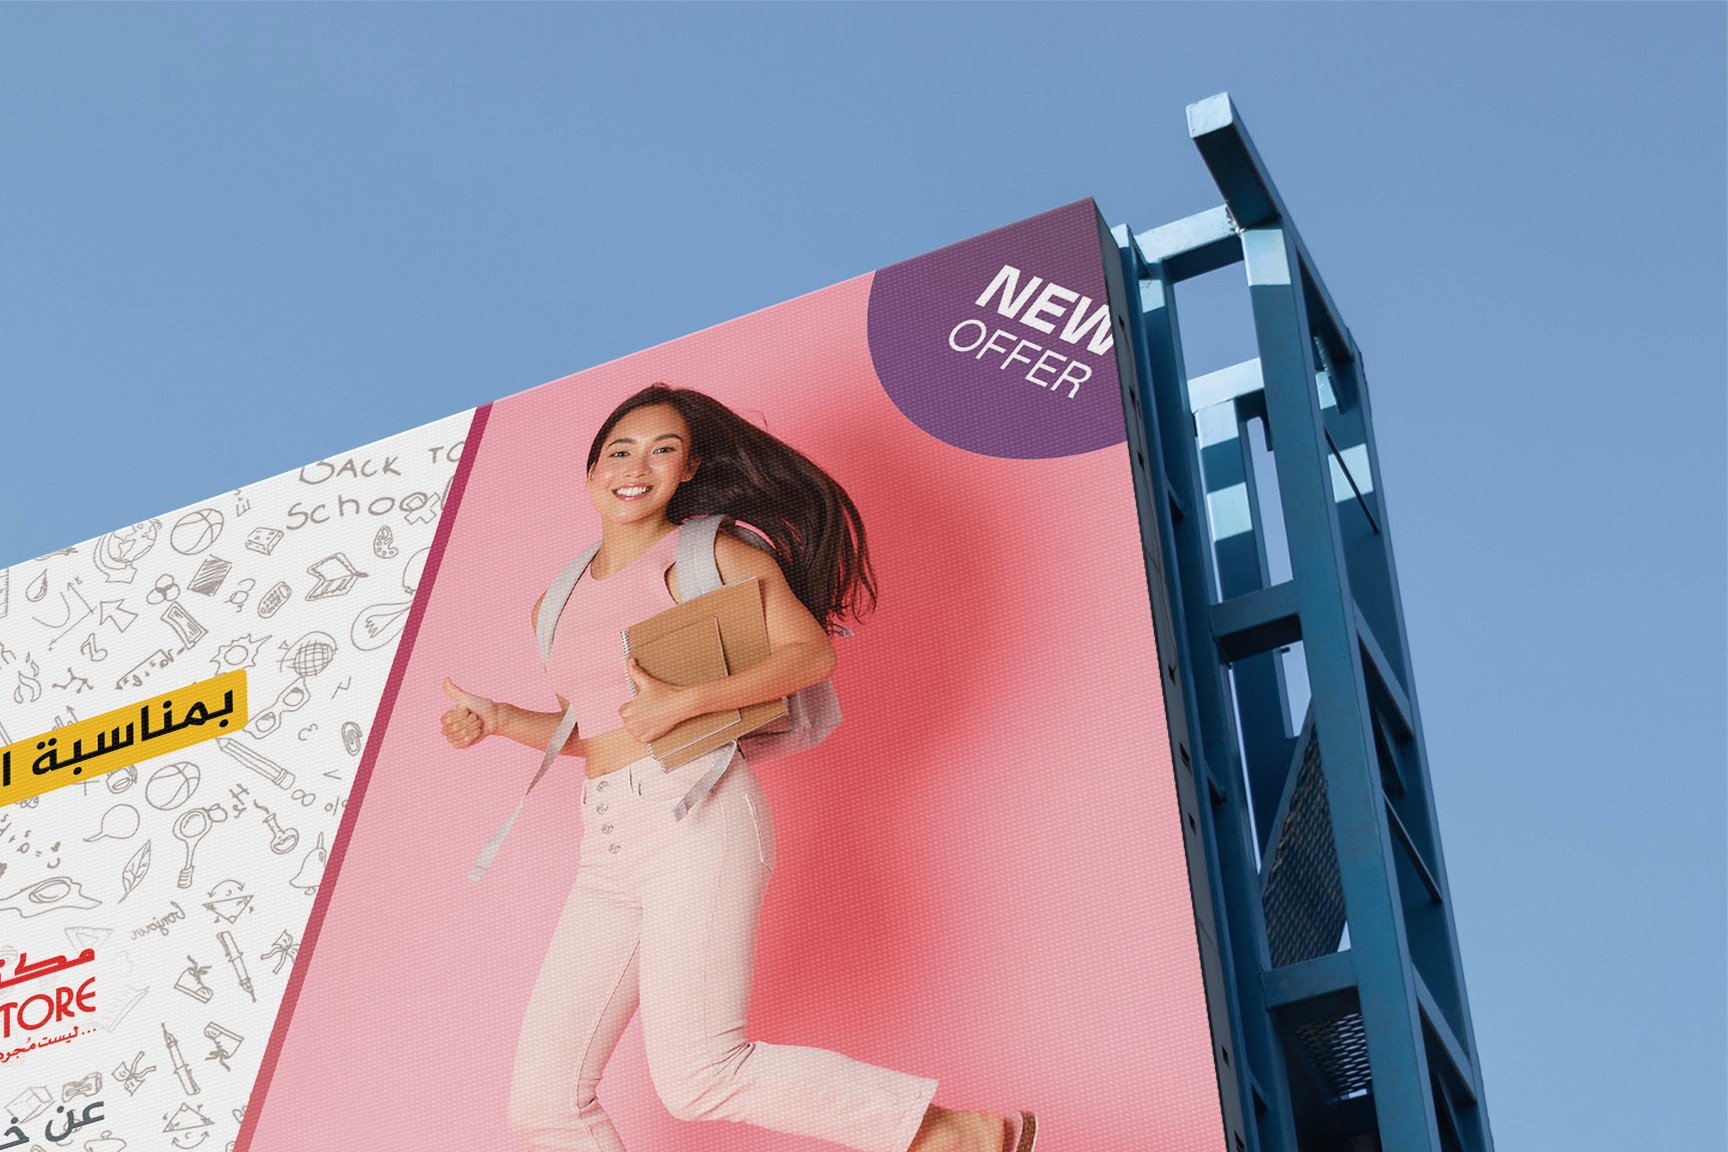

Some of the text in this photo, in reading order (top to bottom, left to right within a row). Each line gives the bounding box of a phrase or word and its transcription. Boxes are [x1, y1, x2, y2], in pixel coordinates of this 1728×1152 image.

[975, 264, 1114, 356] NEW
[949, 319, 1092, 399] OFFER
[32, 689, 234, 776] بمناسبة
[45, 1101, 105, 1142] عن
